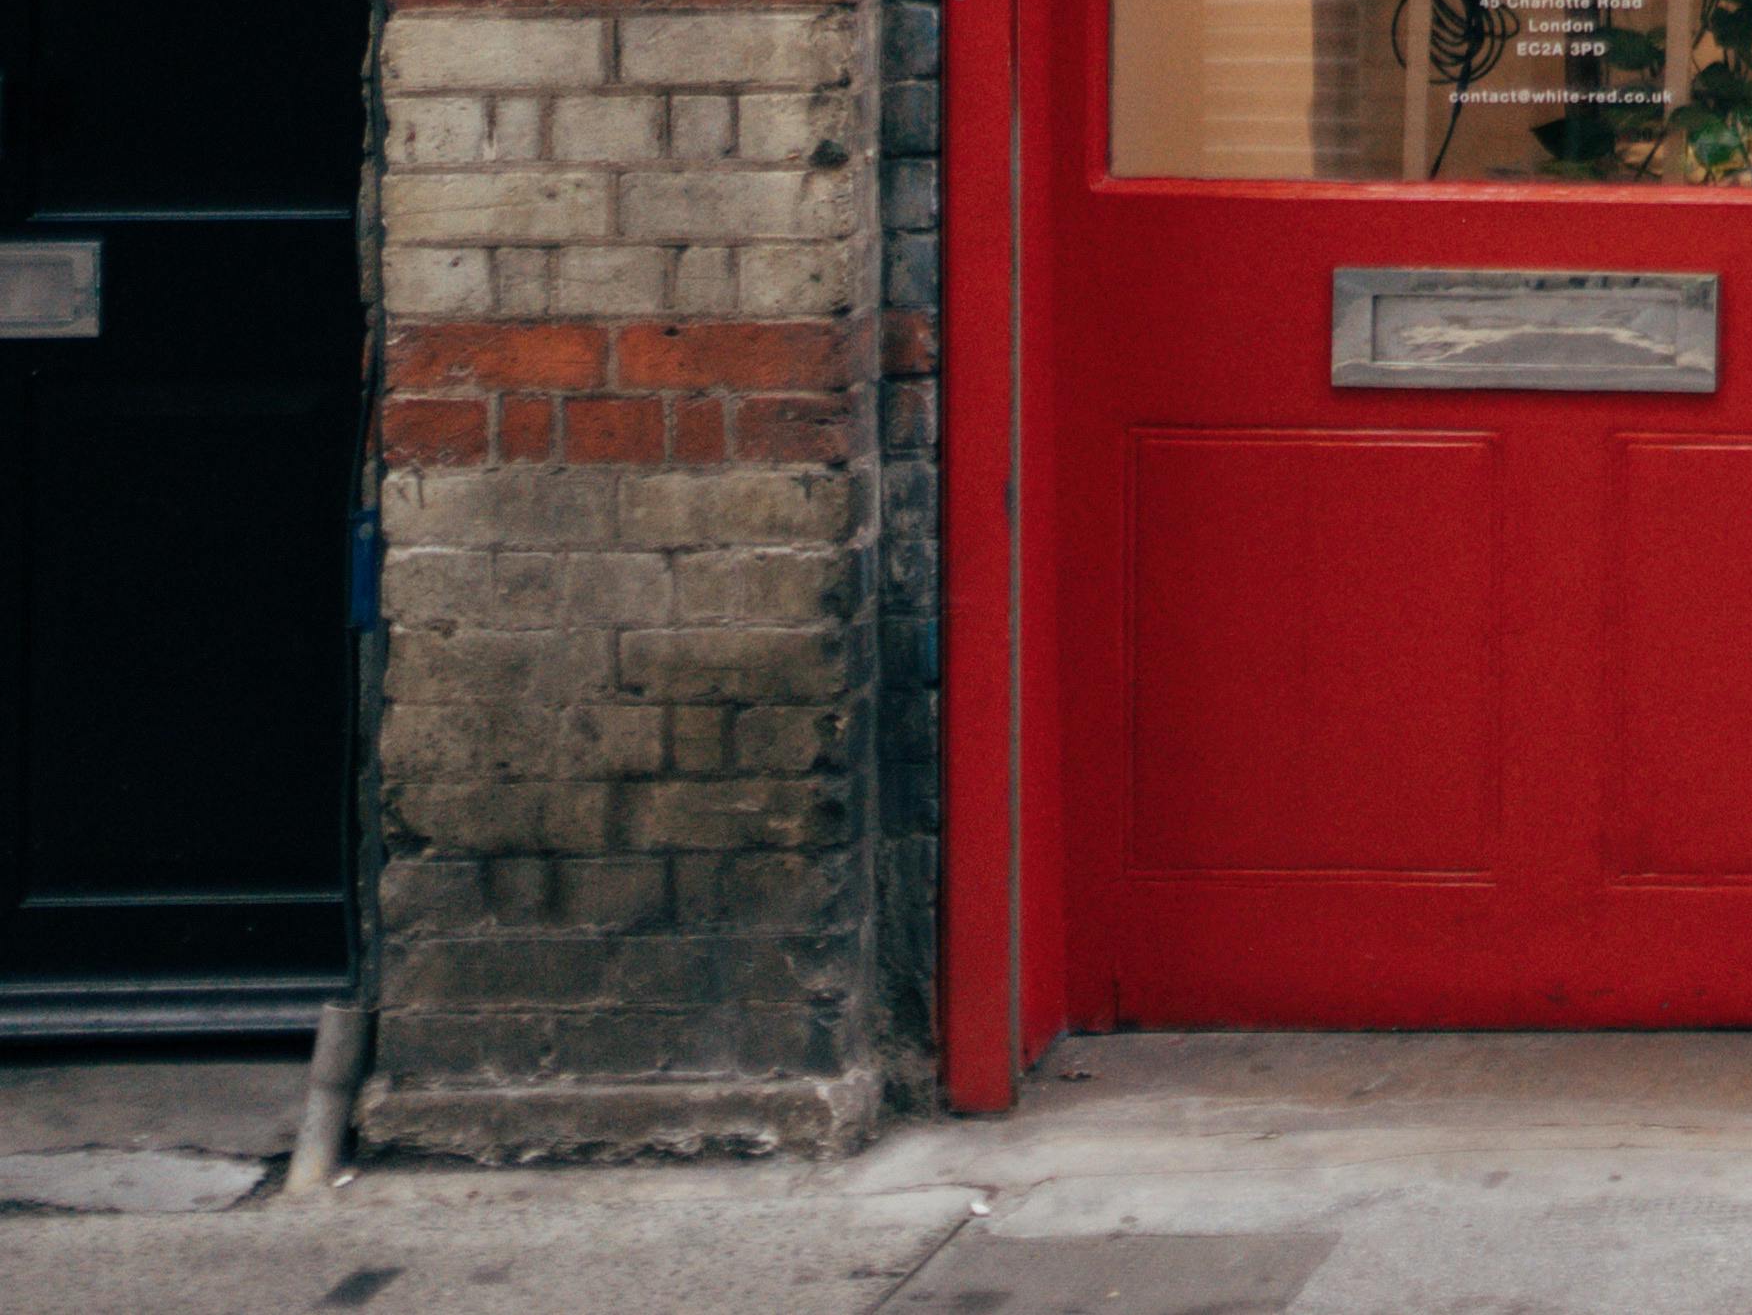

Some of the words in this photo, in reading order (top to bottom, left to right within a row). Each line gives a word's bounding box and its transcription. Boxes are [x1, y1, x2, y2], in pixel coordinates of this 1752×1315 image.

[1528, 19, 1594, 33] London
[1516, 42, 1563, 56] EC2A
[1570, 42, 1606, 56] 3PD
[1449, 89, 1673, 104] contact@white-red.co.uk
